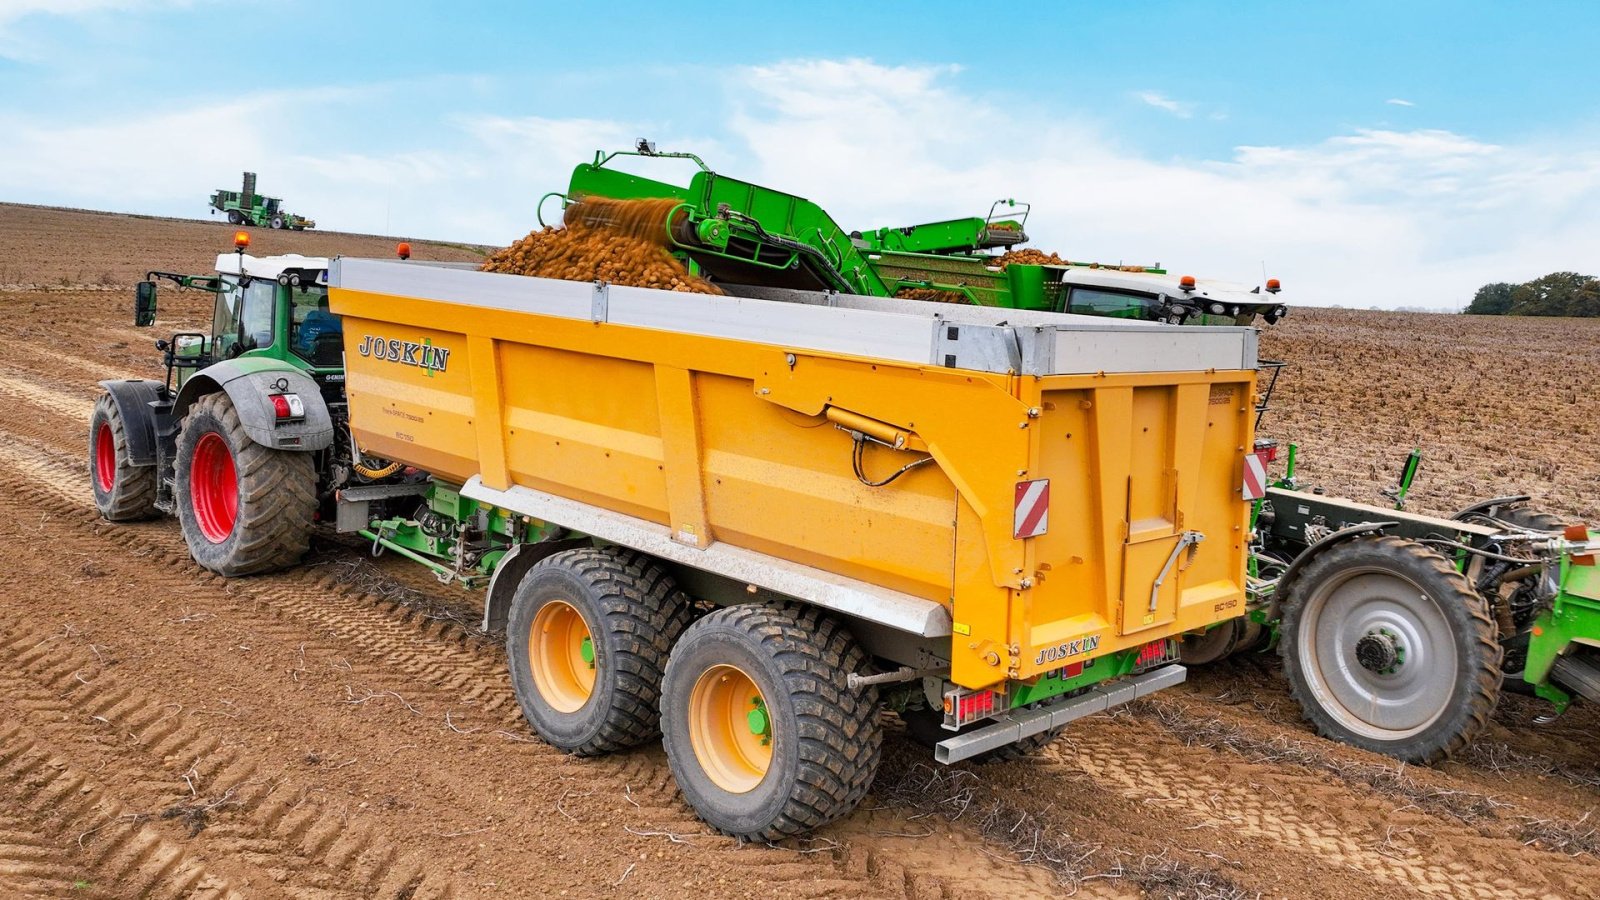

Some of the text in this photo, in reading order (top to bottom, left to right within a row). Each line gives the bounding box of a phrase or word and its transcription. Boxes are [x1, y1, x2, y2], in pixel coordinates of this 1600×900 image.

[359, 335, 450, 372] JOSKIN
[1214, 599, 1238, 612] BC150
[1035, 634, 1101, 666] JOSKIN
